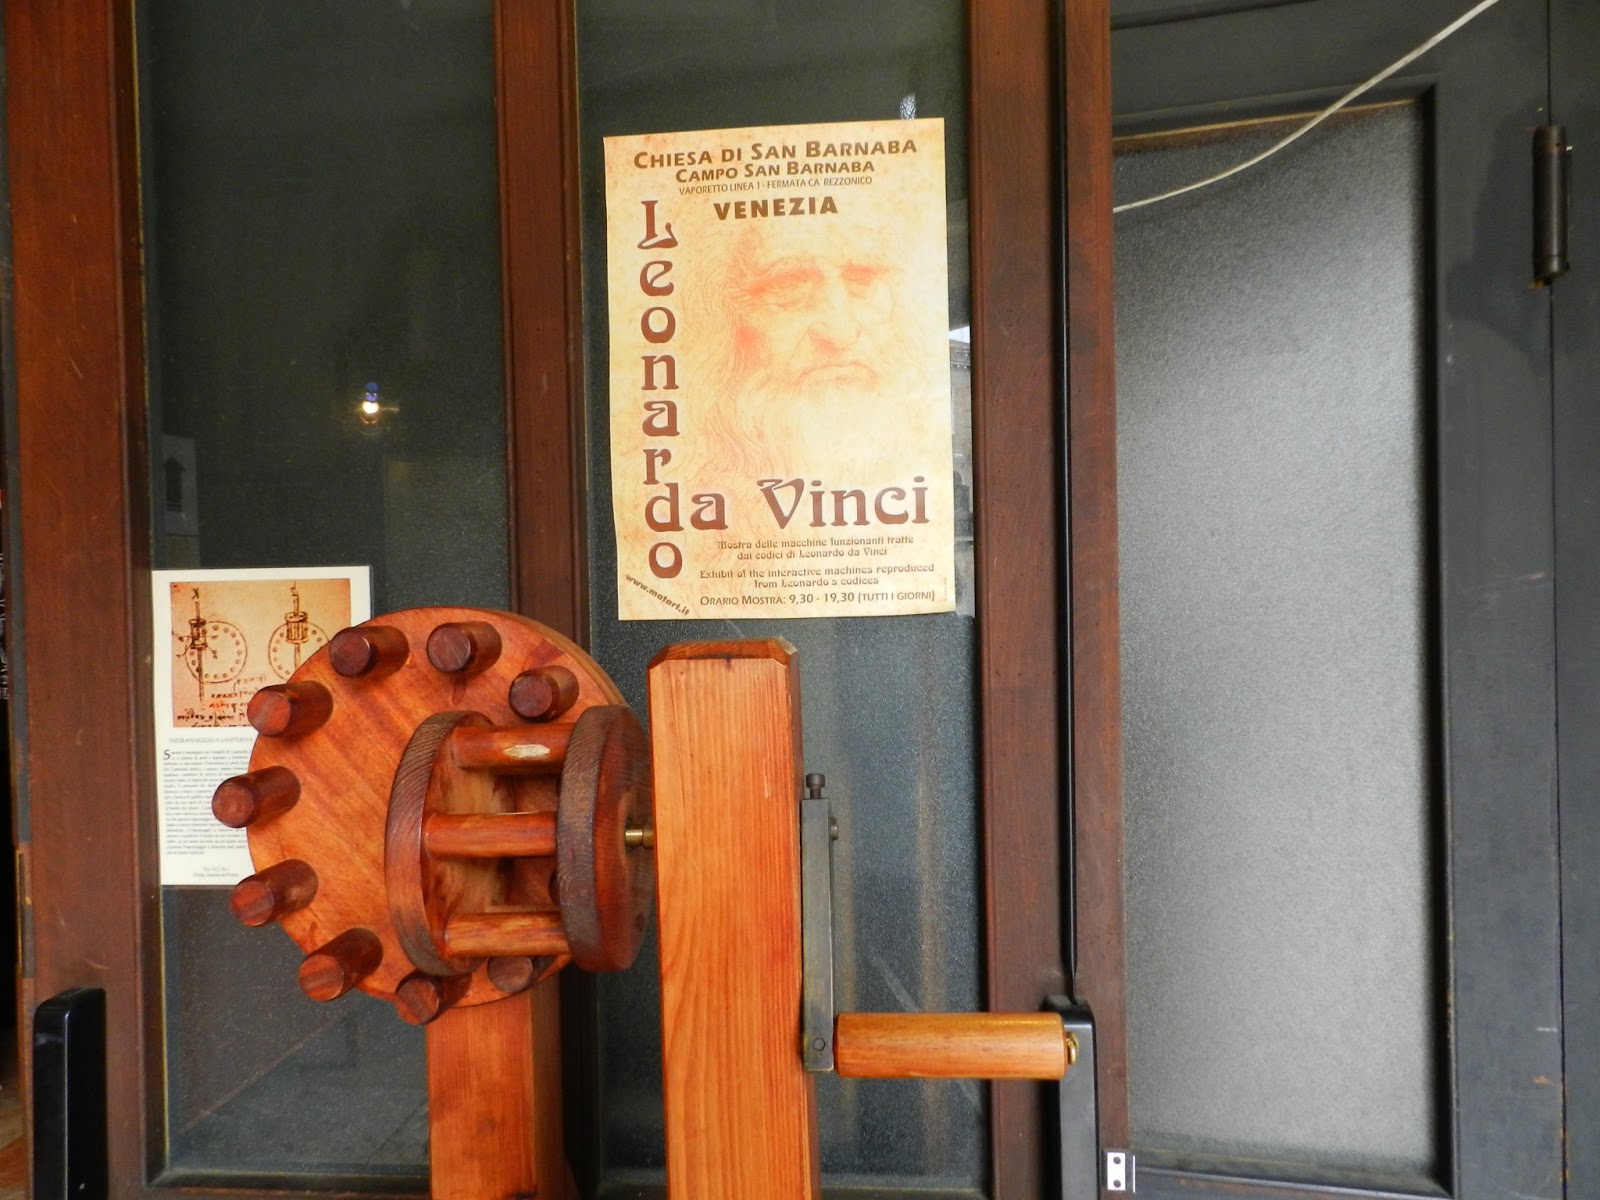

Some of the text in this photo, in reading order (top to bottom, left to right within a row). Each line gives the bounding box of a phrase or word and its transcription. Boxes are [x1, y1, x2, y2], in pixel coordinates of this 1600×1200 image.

[634, 139, 917, 169] CHIESA DI SAN BARNABA
[675, 161, 875, 183] CAMPO SAN BARNABA
[679, 183, 728, 195] VAPORETTO
[730, 181, 754, 192] LINEA
[756, 181, 760, 190] 1
[767, 178, 806, 189] FERMATA
[823, 176, 873, 187] REZZONICO
[713, 196, 838, 221] VENEZIA
[637, 199, 684, 579] Leonardo
[756, 476, 930, 530] Vinci
[717, 535, 914, 550] Mostra delle macchine funzionanti tratte
[737, 547, 887, 560] dai codici di Leonardo da Vinci
[700, 563, 935, 579] Exhibit of the interactive machines reproduced
[754, 575, 879, 588] from Leonardo's codices
[625, 574, 690, 616] www.matart.it
[700, 595, 739, 606] ORARIO
[742, 595, 786, 605] MOSTRA:
[789, 593, 814, 605] 9,30
[824, 592, 855, 603] 19,30
[858, 591, 888, 604] (TUTTI
[891, 592, 894, 601] I
[896, 590, 935, 602] GIORNI)
